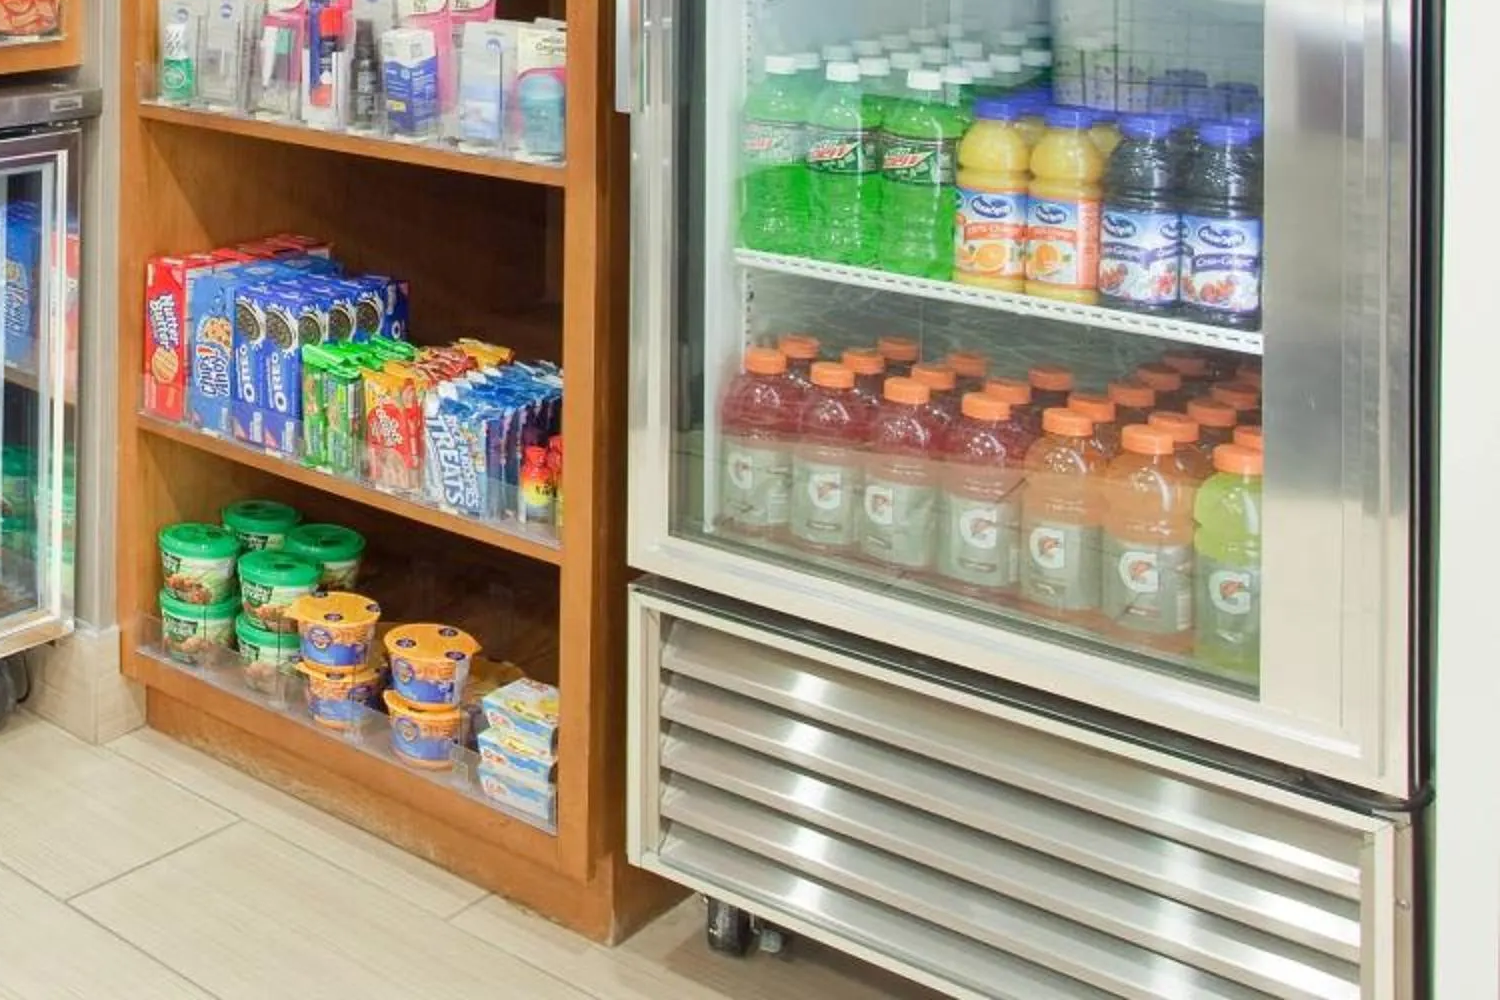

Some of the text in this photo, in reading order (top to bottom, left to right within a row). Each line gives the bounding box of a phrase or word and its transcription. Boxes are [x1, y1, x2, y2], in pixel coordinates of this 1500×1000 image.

[238, 345, 256, 403] OREO
[271, 352, 287, 413] OREO
[427, 412, 464, 506] TREATS
